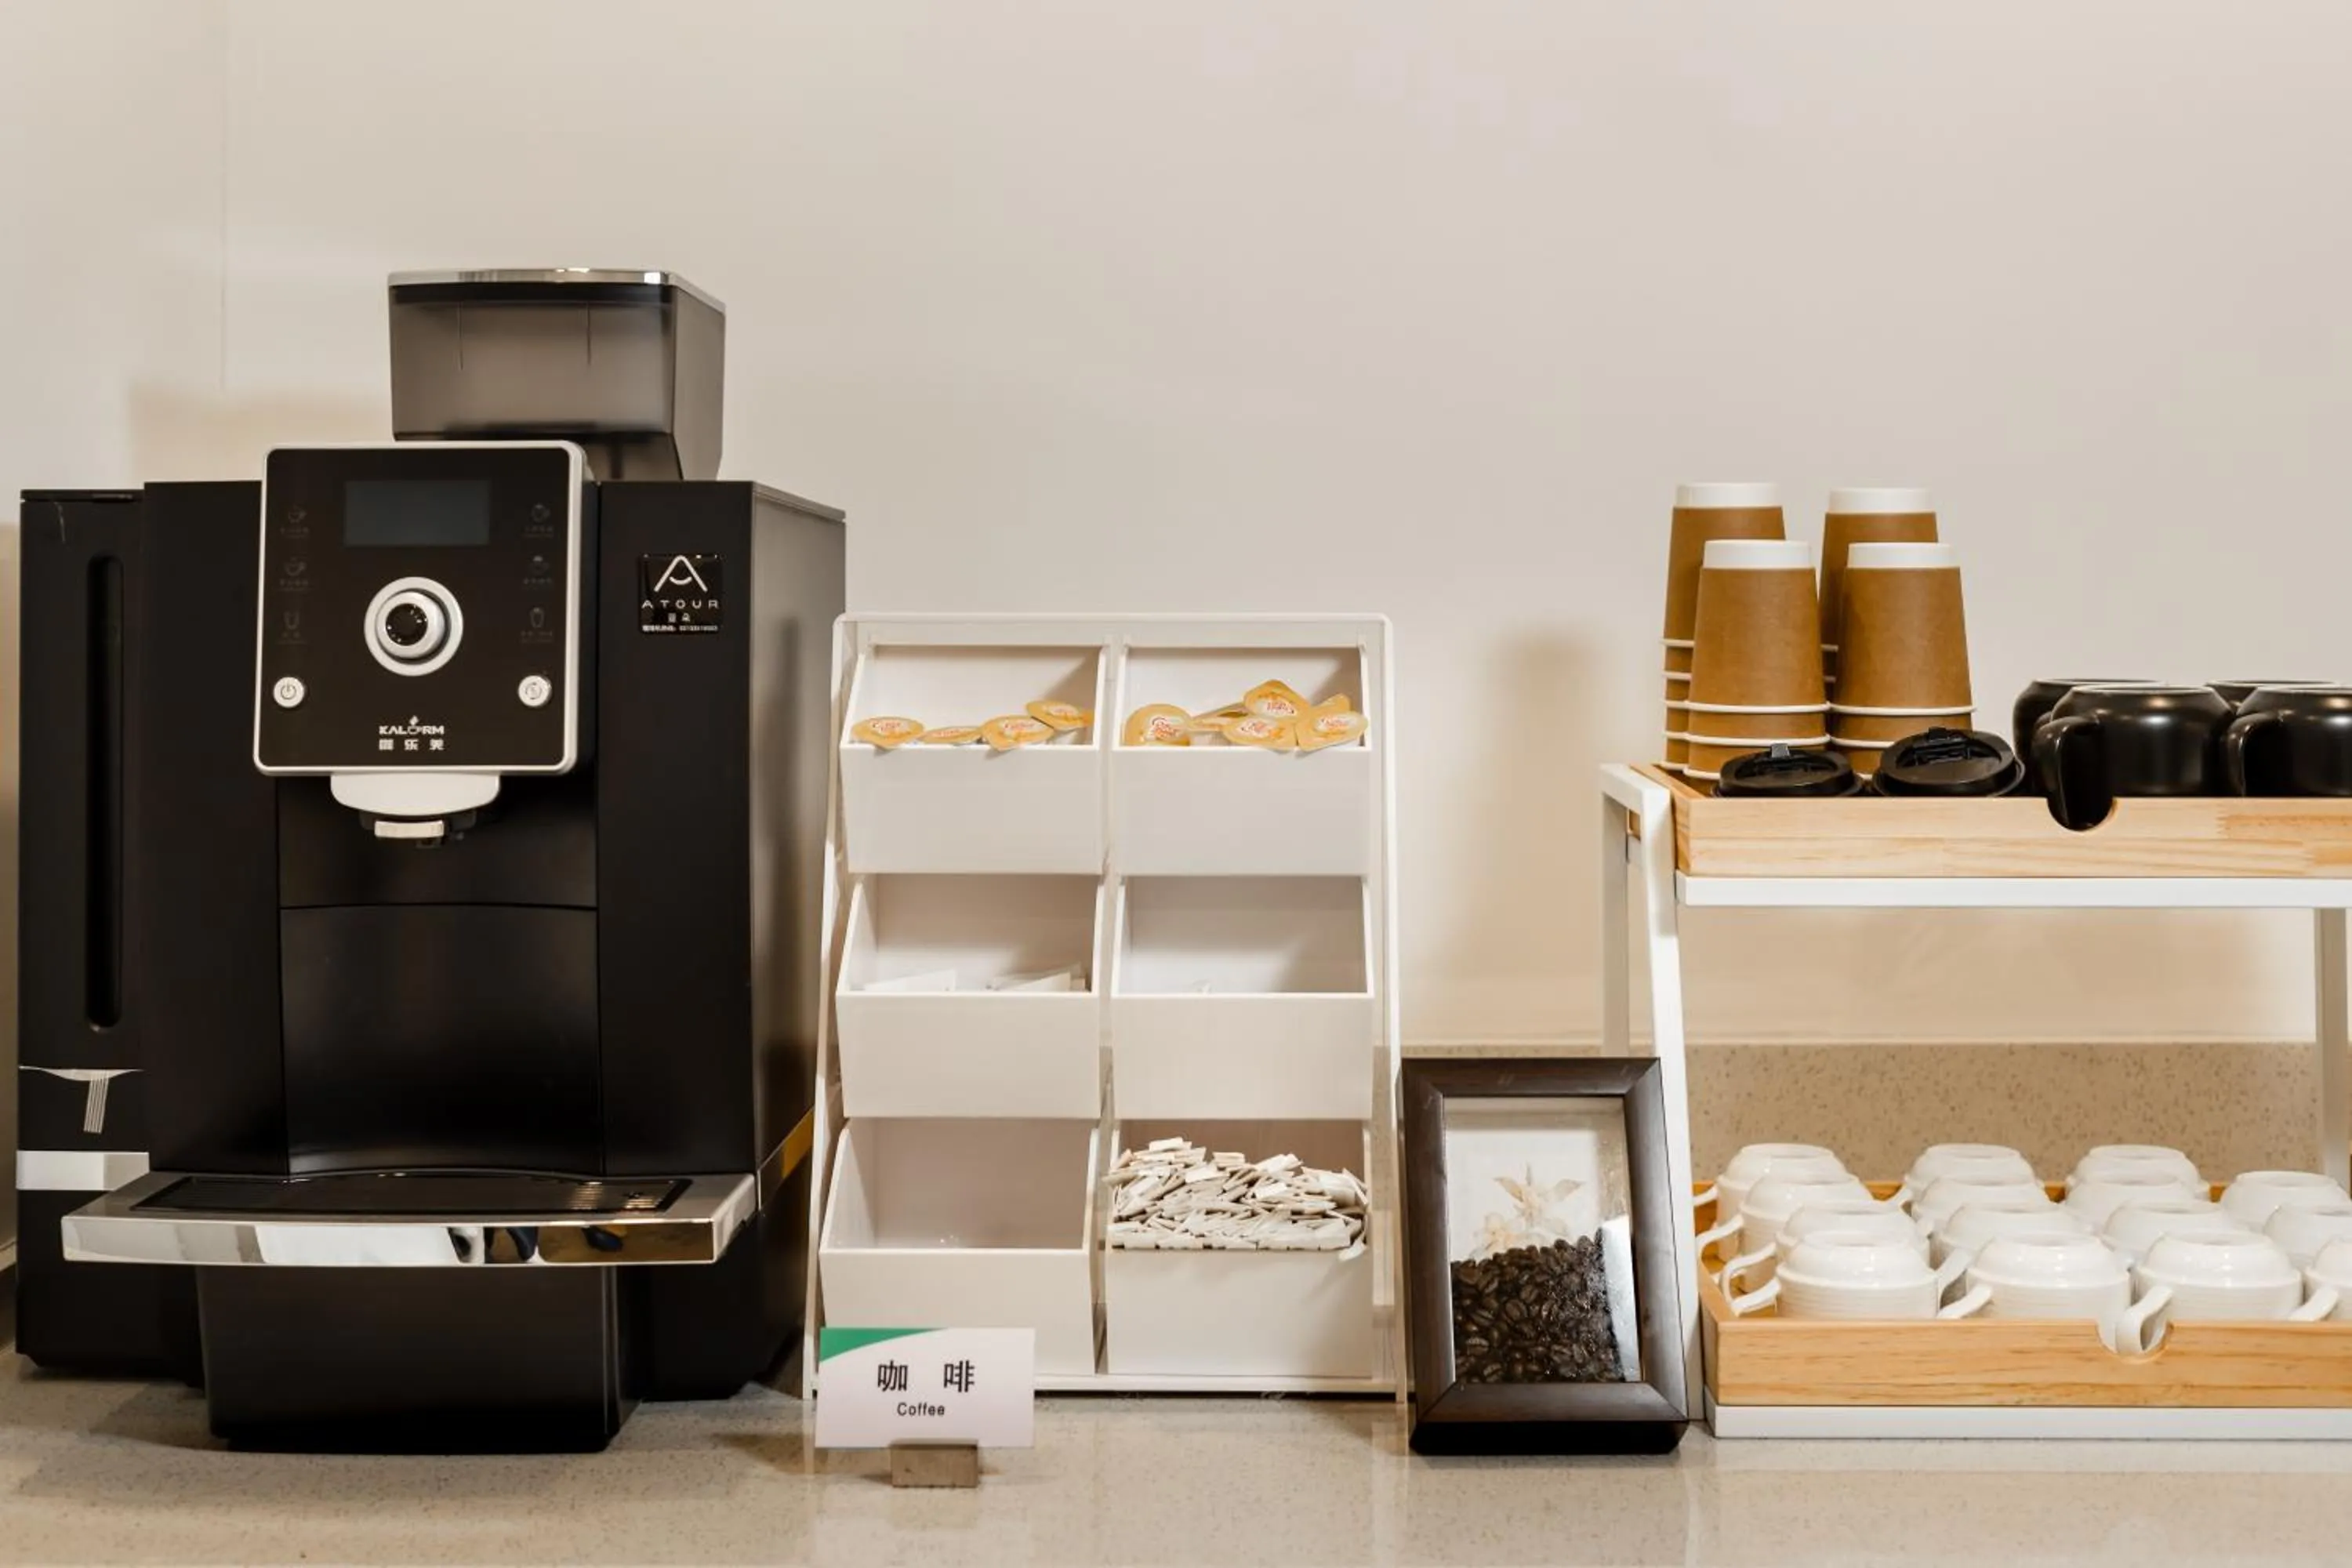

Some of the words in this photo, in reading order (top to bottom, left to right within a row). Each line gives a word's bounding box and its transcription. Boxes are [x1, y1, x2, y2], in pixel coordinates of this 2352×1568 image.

[641, 600, 720, 609] ATOUR
[877, 1359, 975, 1392] 咖啡
[897, 1402, 946, 1416] Coffee
